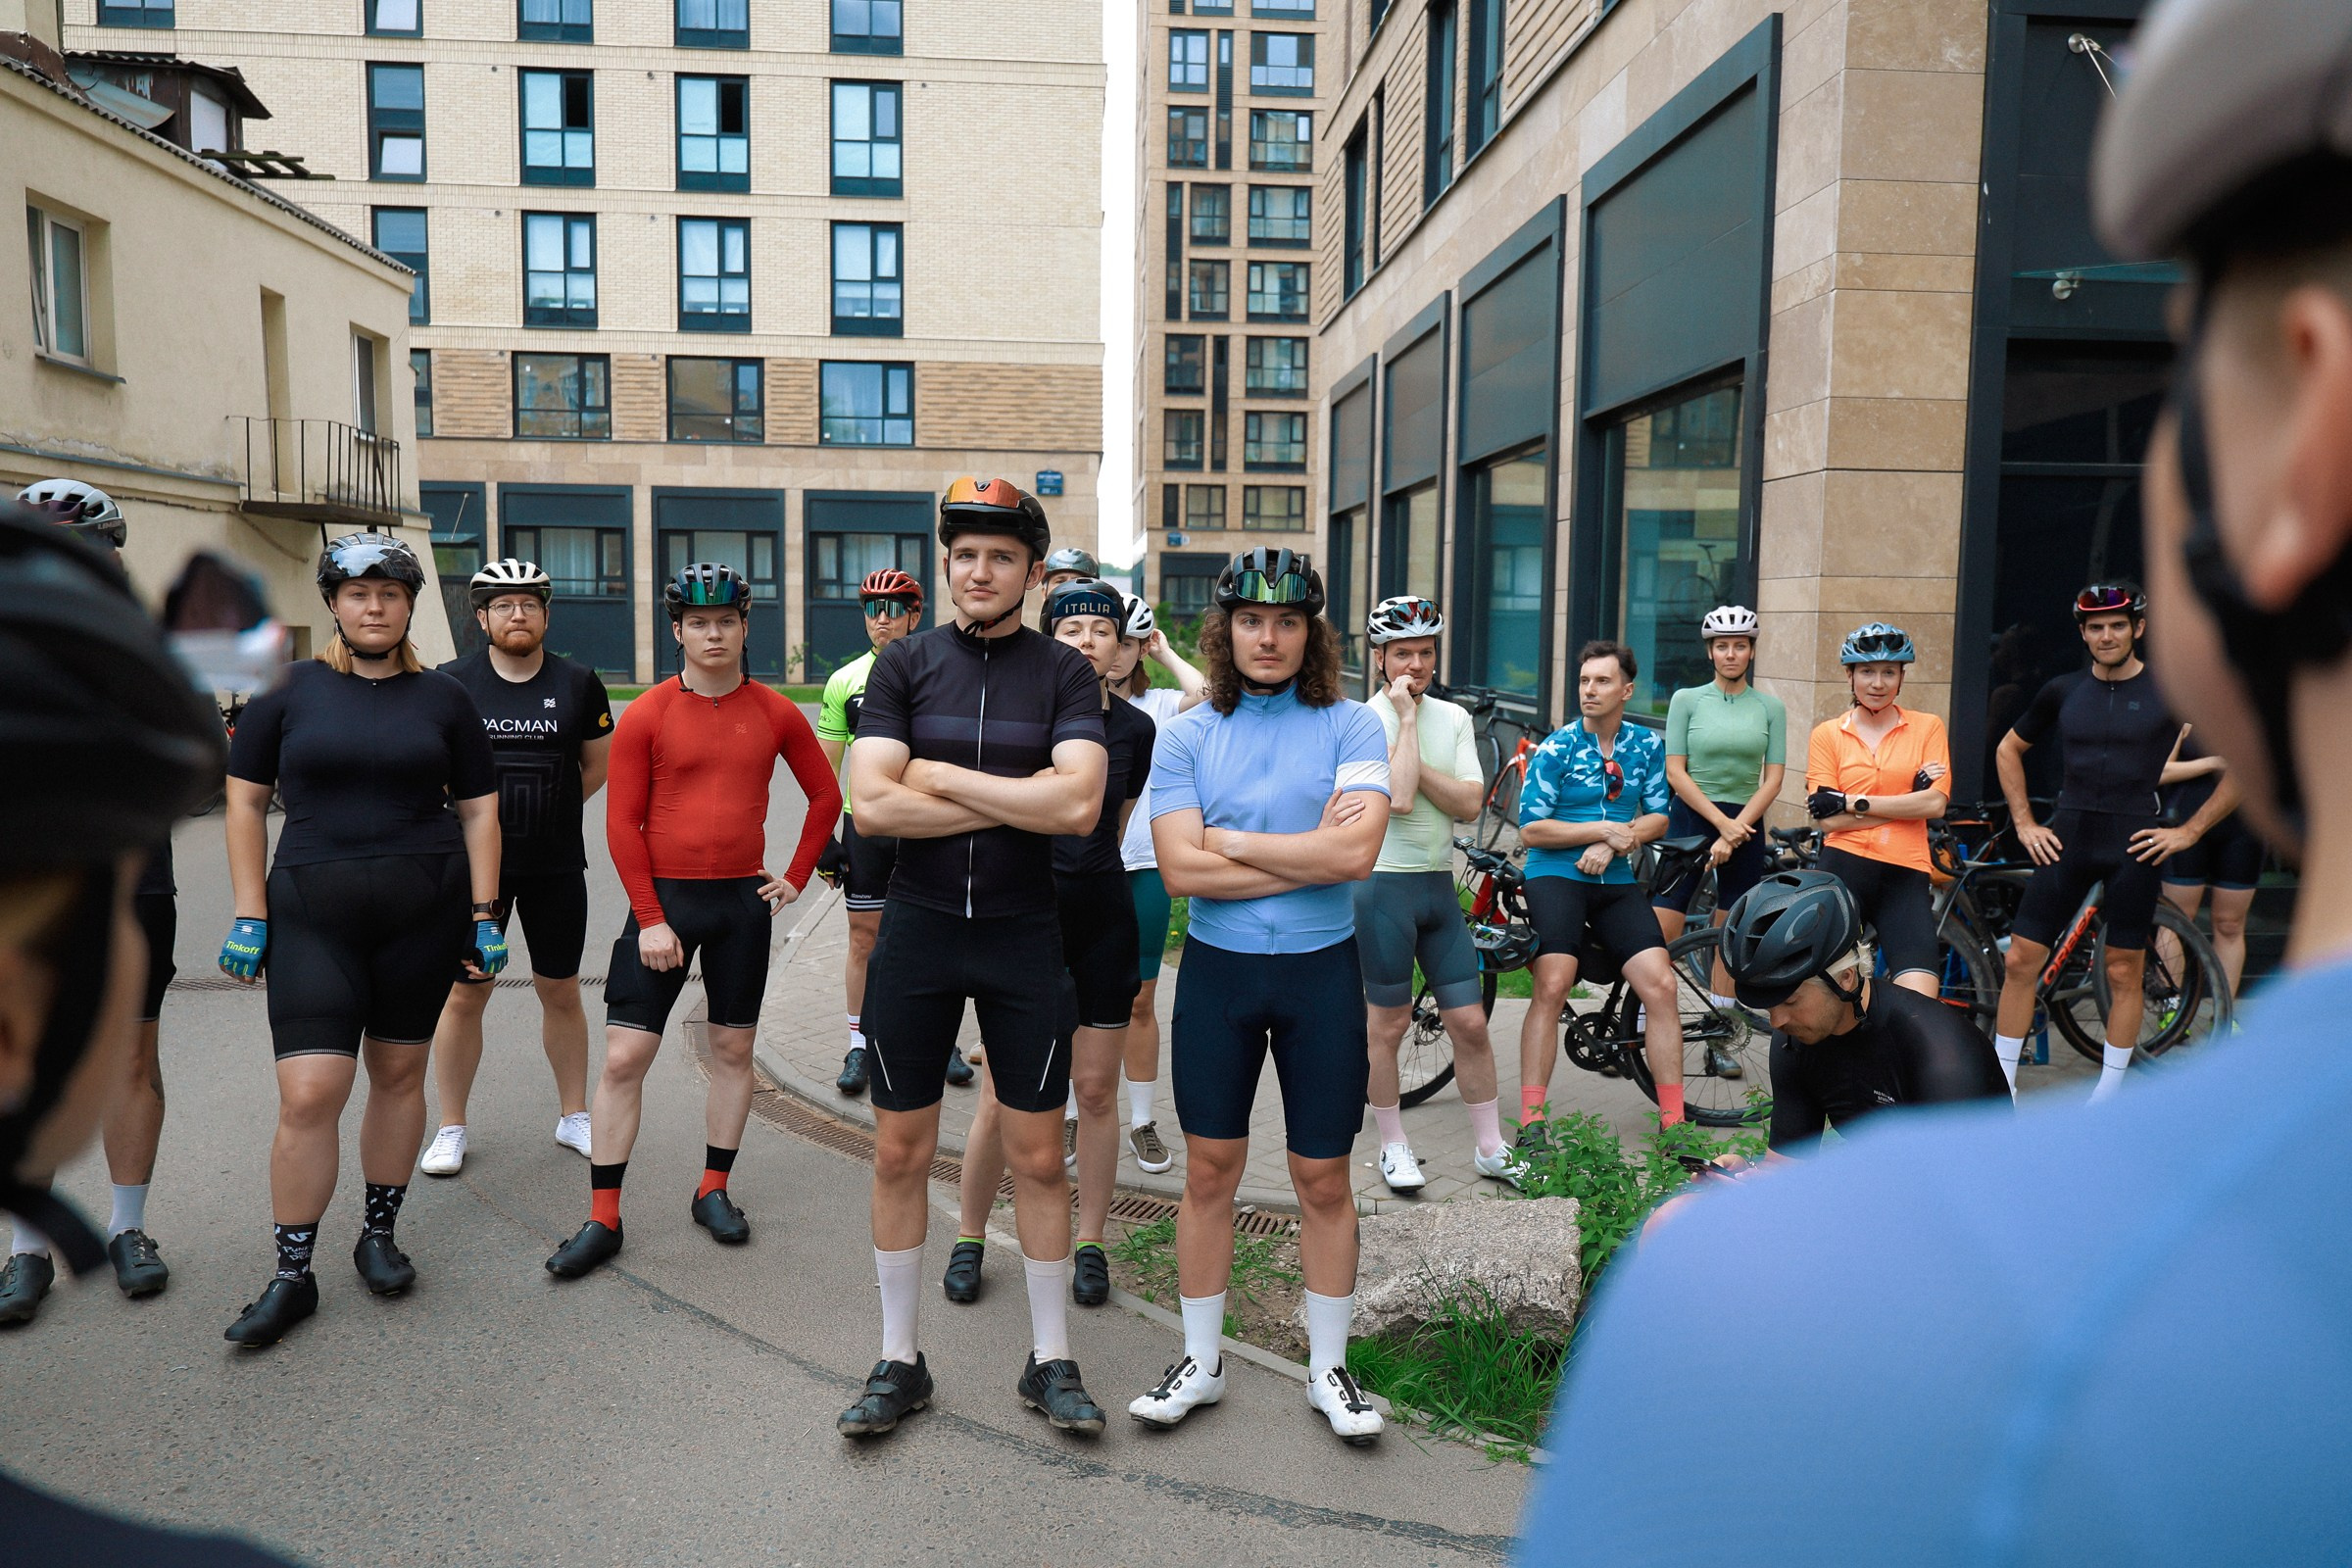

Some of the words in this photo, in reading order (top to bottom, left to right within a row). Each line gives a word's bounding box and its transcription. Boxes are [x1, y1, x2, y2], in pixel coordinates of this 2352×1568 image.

[1065, 603, 1110, 613] ITALIA
[226, 940, 261, 956] Tinkoff
[2043, 906, 2098, 985] ORBEA
